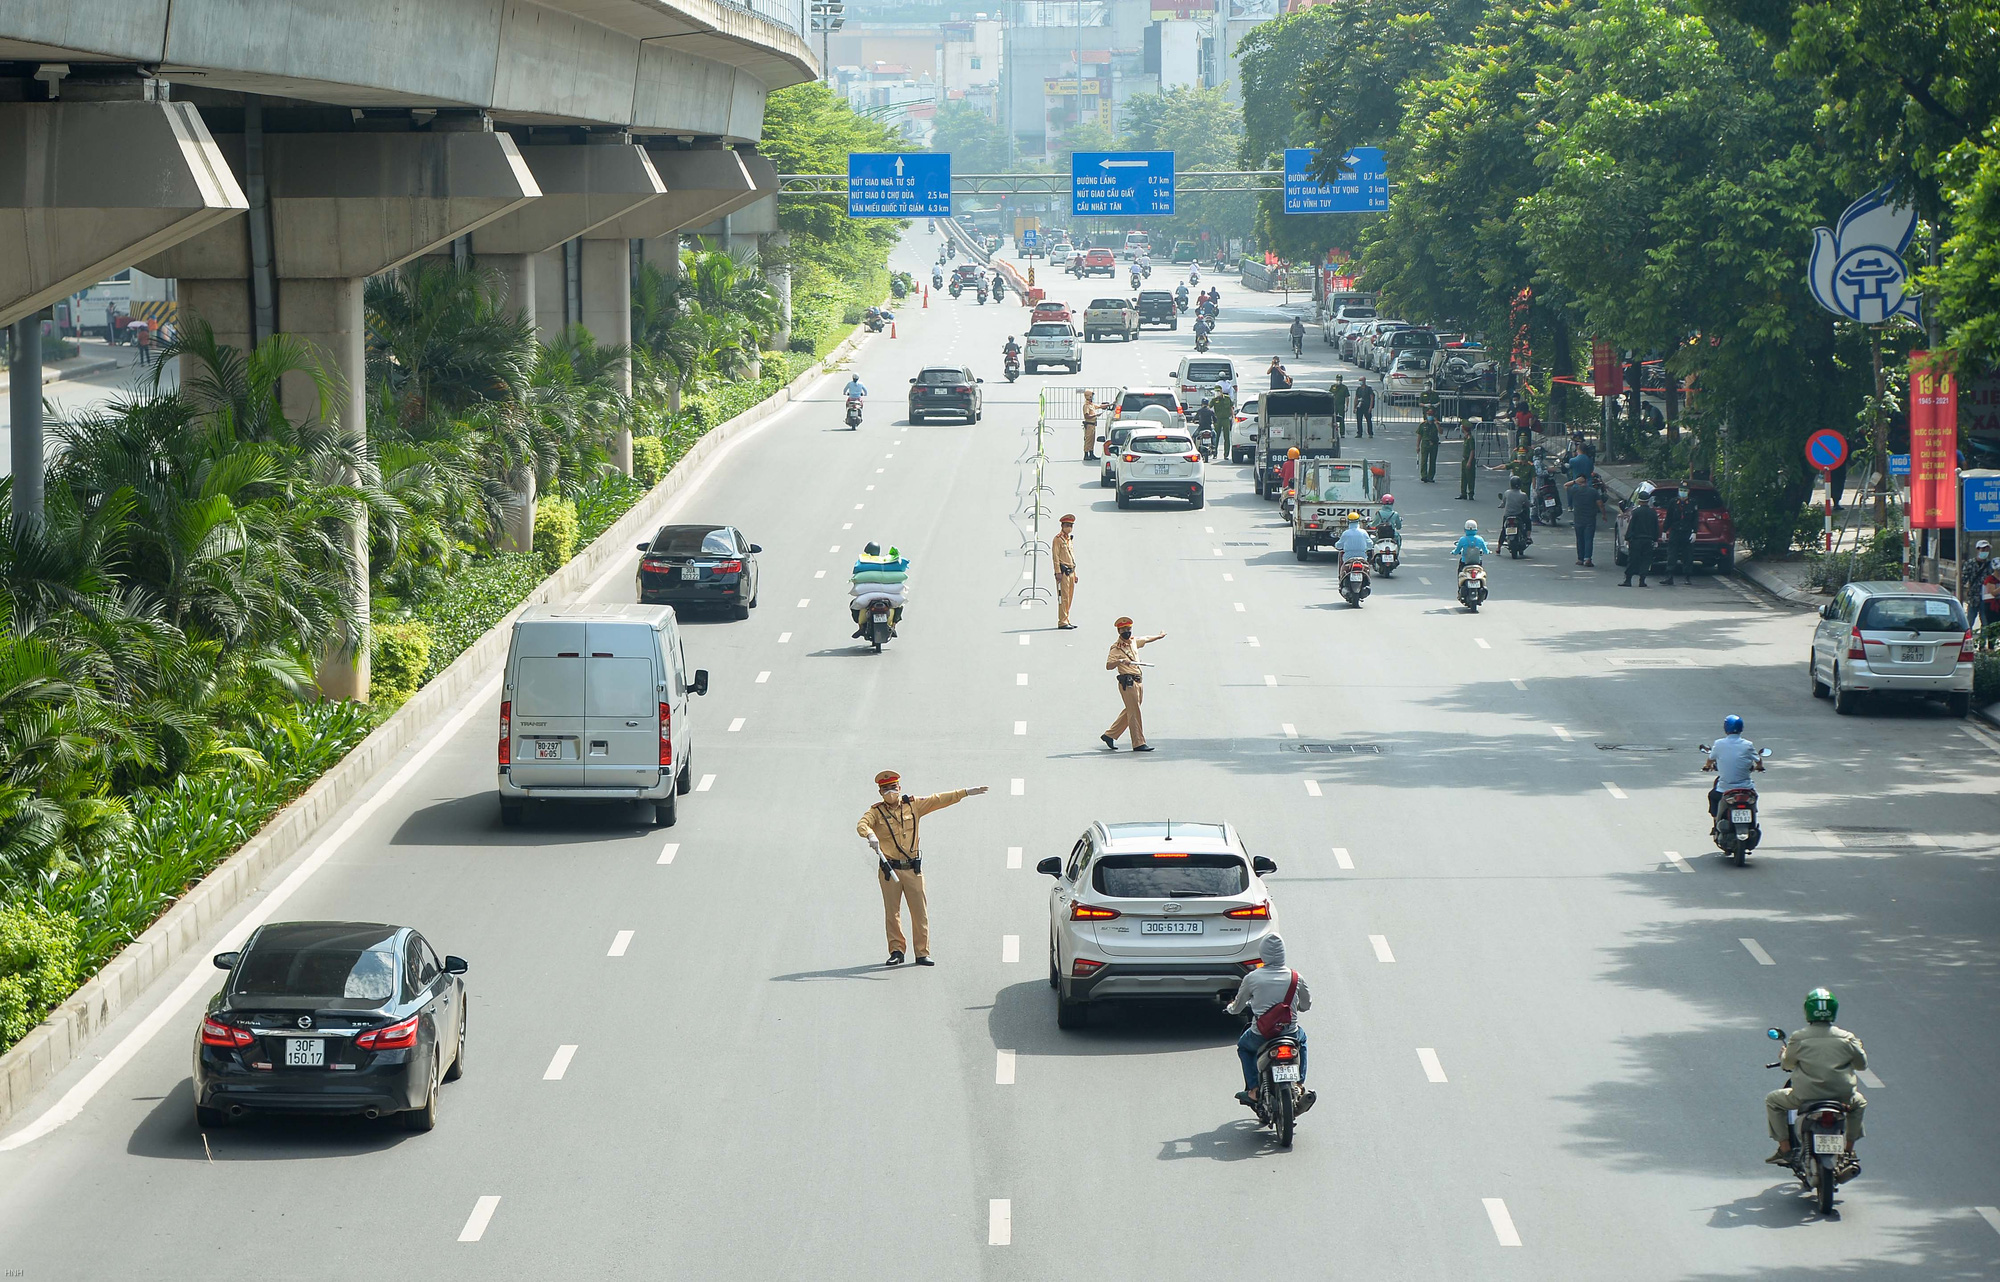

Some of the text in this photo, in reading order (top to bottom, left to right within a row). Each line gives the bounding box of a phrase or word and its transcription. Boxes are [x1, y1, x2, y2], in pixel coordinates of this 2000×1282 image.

[851, 176, 915, 186] NÚT GIAO NGÃ TƯ SỞ
[1077, 175, 1098, 184] ĐƯỜNG
[1100, 175, 1116, 184] LÁNG
[1159, 176, 1169, 184] km
[1375, 172, 1385, 180] km
[851, 189, 863, 199] NÚT
[865, 191, 879, 199] GIAO
[887, 191, 900, 200] CHỢ
[902, 189, 914, 199] DỪA
[939, 191, 949, 199] km
[1077, 188, 1089, 198] NÚT
[1091, 190, 1105, 198] GIAO
[1107, 188, 1119, 197] CẦU
[1121, 187, 1135, 197] GIẤY
[1288, 185, 1385, 195] NÚT GIAO NGÃ TƯ VỌNG 3 km
[852, 203, 863, 212] VĂN
[865, 201, 880, 212] MIẾU
[881, 202, 898, 212] QUỐC
[899, 202, 907, 212] TỬ
[909, 202, 924, 212] GIÁM
[1077, 201, 1169, 212] CẦU NHẬT TÂN 11 km
[1288, 199, 1301, 208] CẦU
[1303, 198, 1318, 208] VĨNH
[1320, 199, 1332, 207] TUY
[1375, 198, 1385, 206] km
[1918, 397, 1932, 405] 1945
[1935, 397, 1949, 405] 2021
[295, 1040, 315, 1051] 30F
[288, 1052, 323, 1065] 150.17
